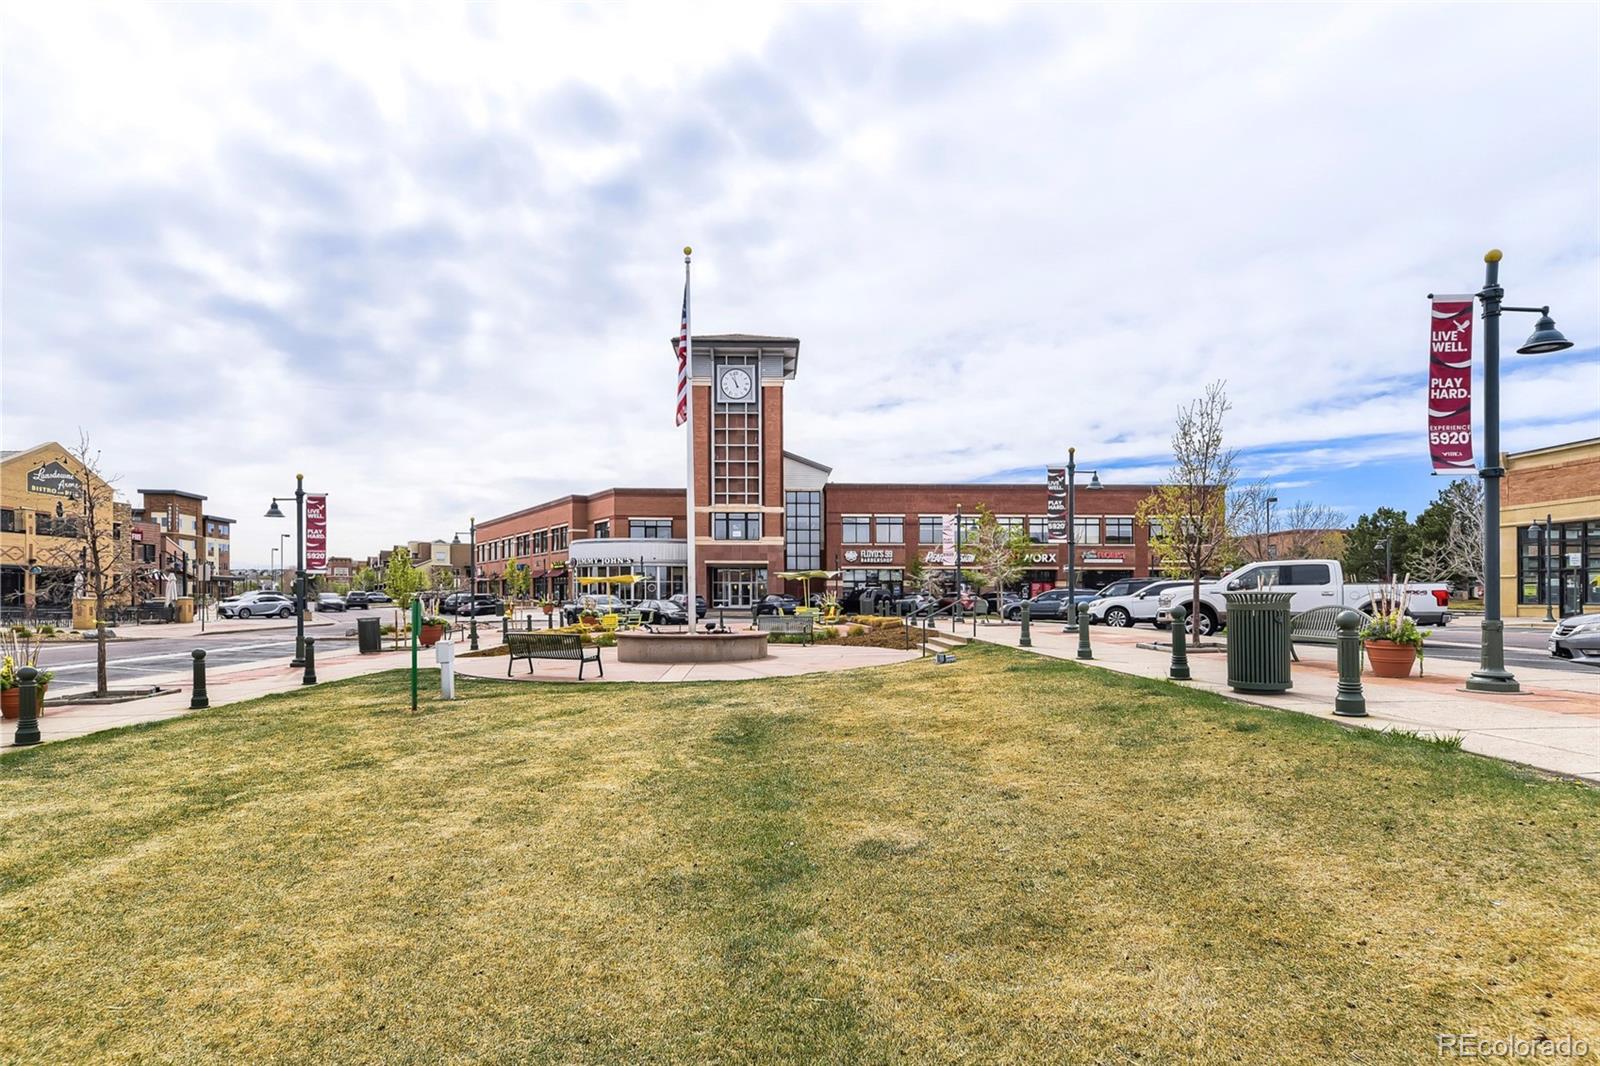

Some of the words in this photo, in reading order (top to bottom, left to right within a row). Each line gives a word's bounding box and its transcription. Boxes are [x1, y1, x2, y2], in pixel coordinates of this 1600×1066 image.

[1432, 331, 1458, 342] LIVE
[1432, 342, 1468, 352] WELL.
[1431, 378, 1464, 388] PLAY
[1430, 389, 1471, 399] HARD.
[31, 485, 57, 494] BISTRO
